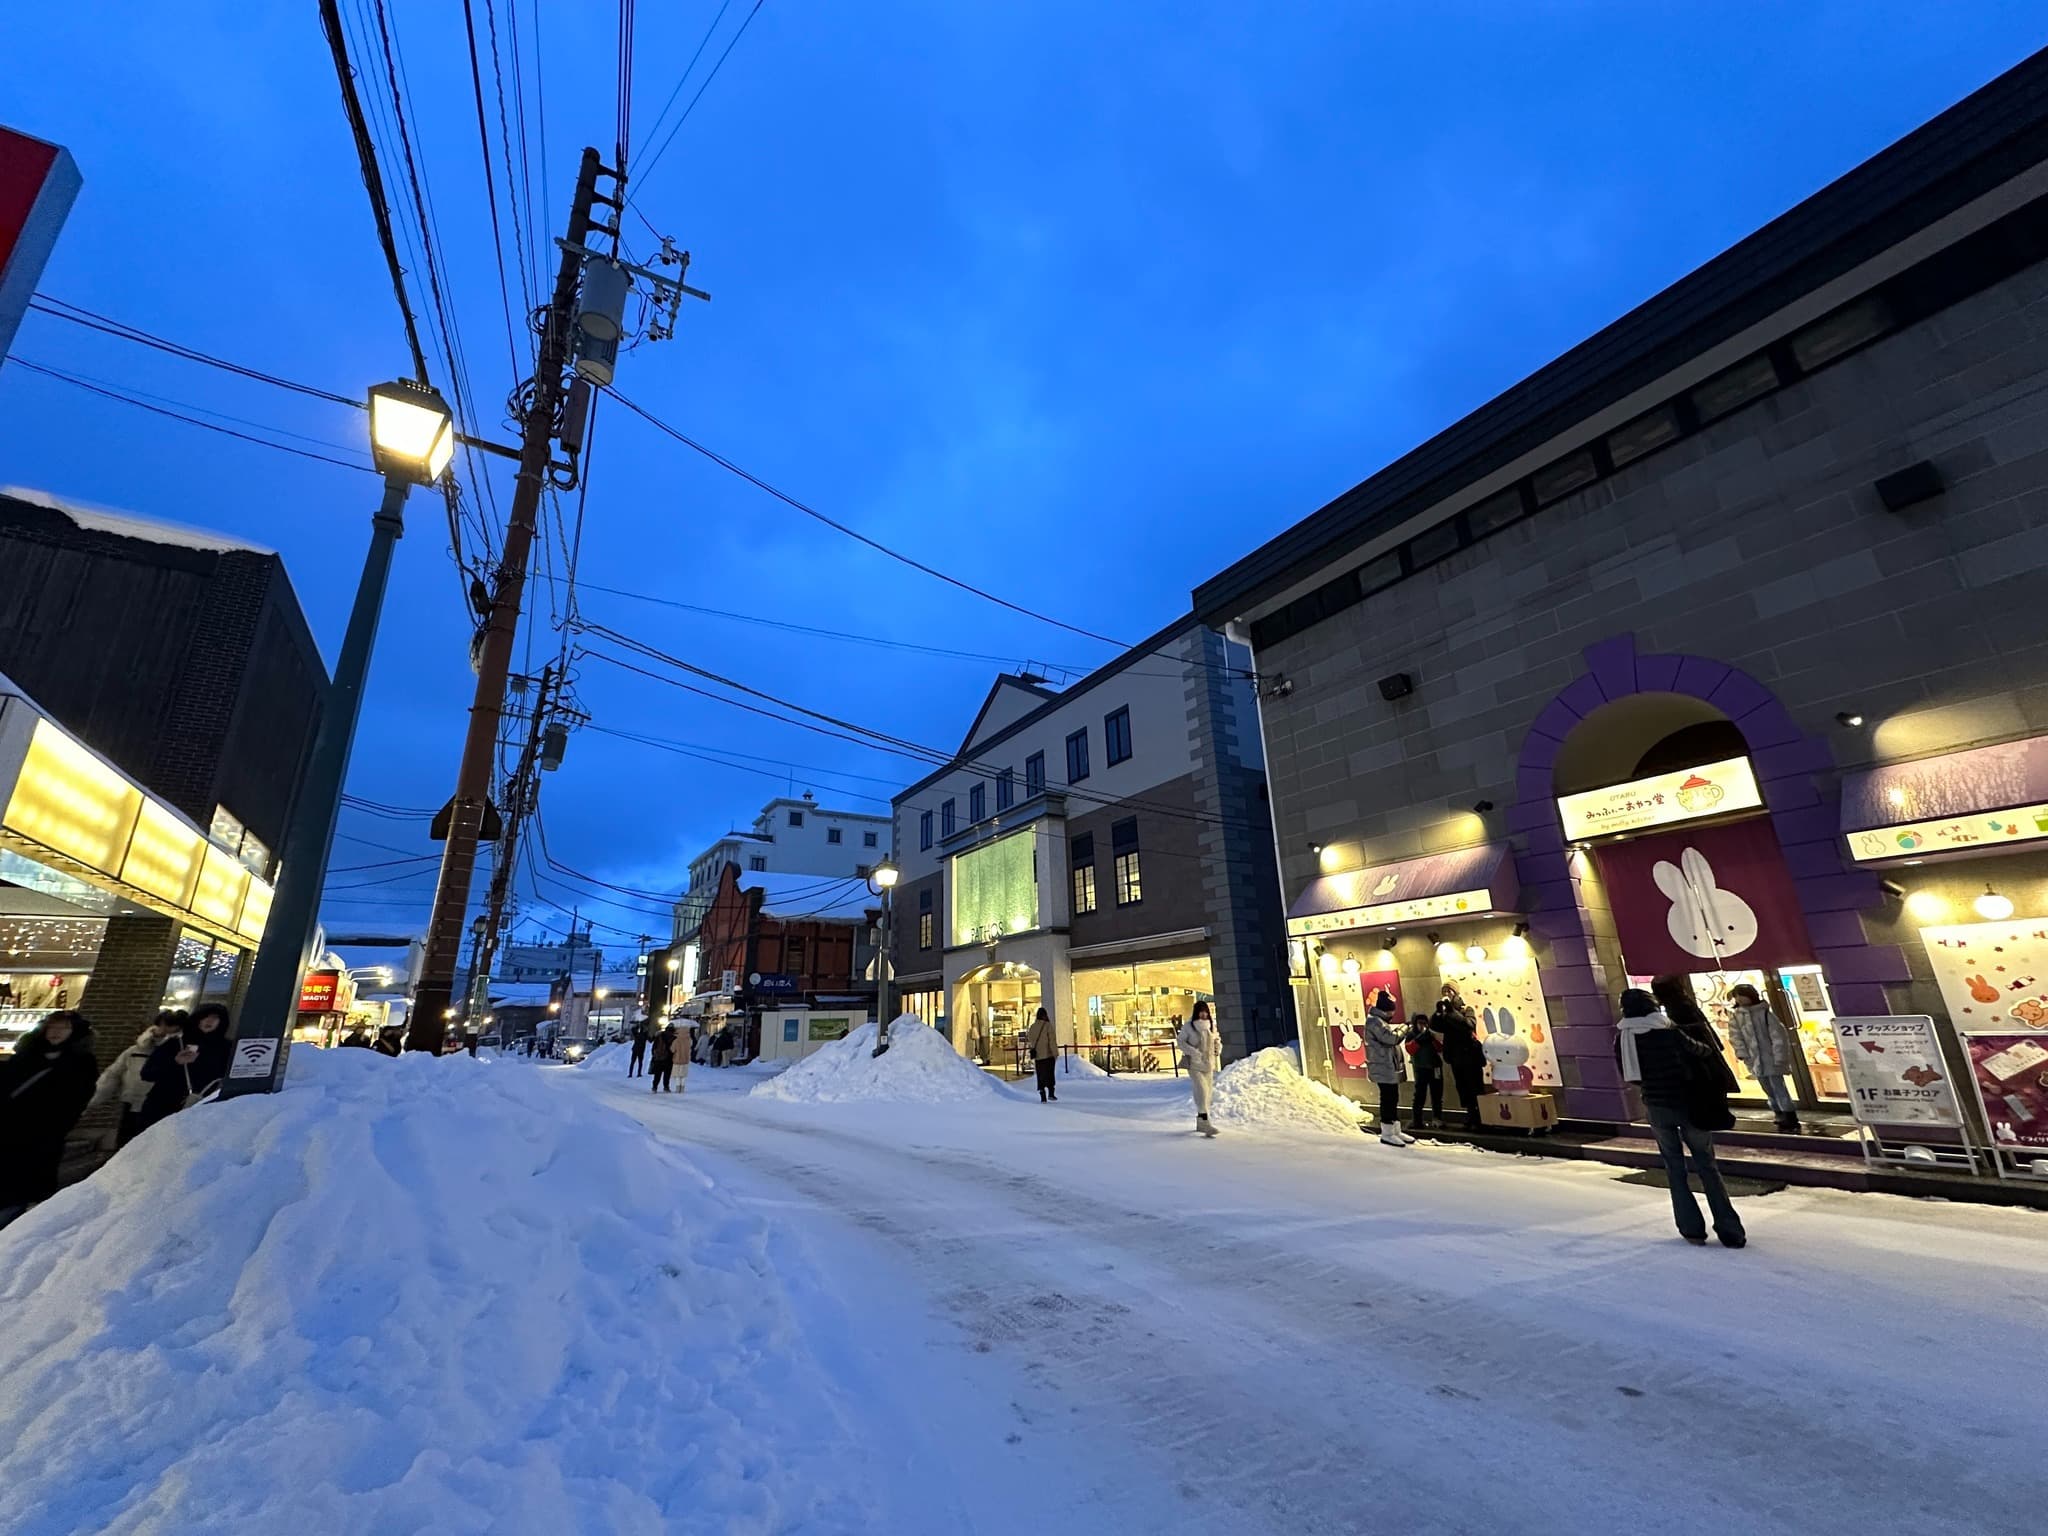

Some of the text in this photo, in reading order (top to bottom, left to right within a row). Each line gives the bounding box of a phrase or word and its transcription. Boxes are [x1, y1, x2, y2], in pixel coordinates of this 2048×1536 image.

[1609, 791, 1636, 801] OTARU
[1586, 793, 1664, 819] みっふぃーおやつ堂
[970, 921, 1004, 943] PATHOS
[1840, 1024, 1863, 1037] 2F
[1856, 1087, 1878, 1101] 1F
